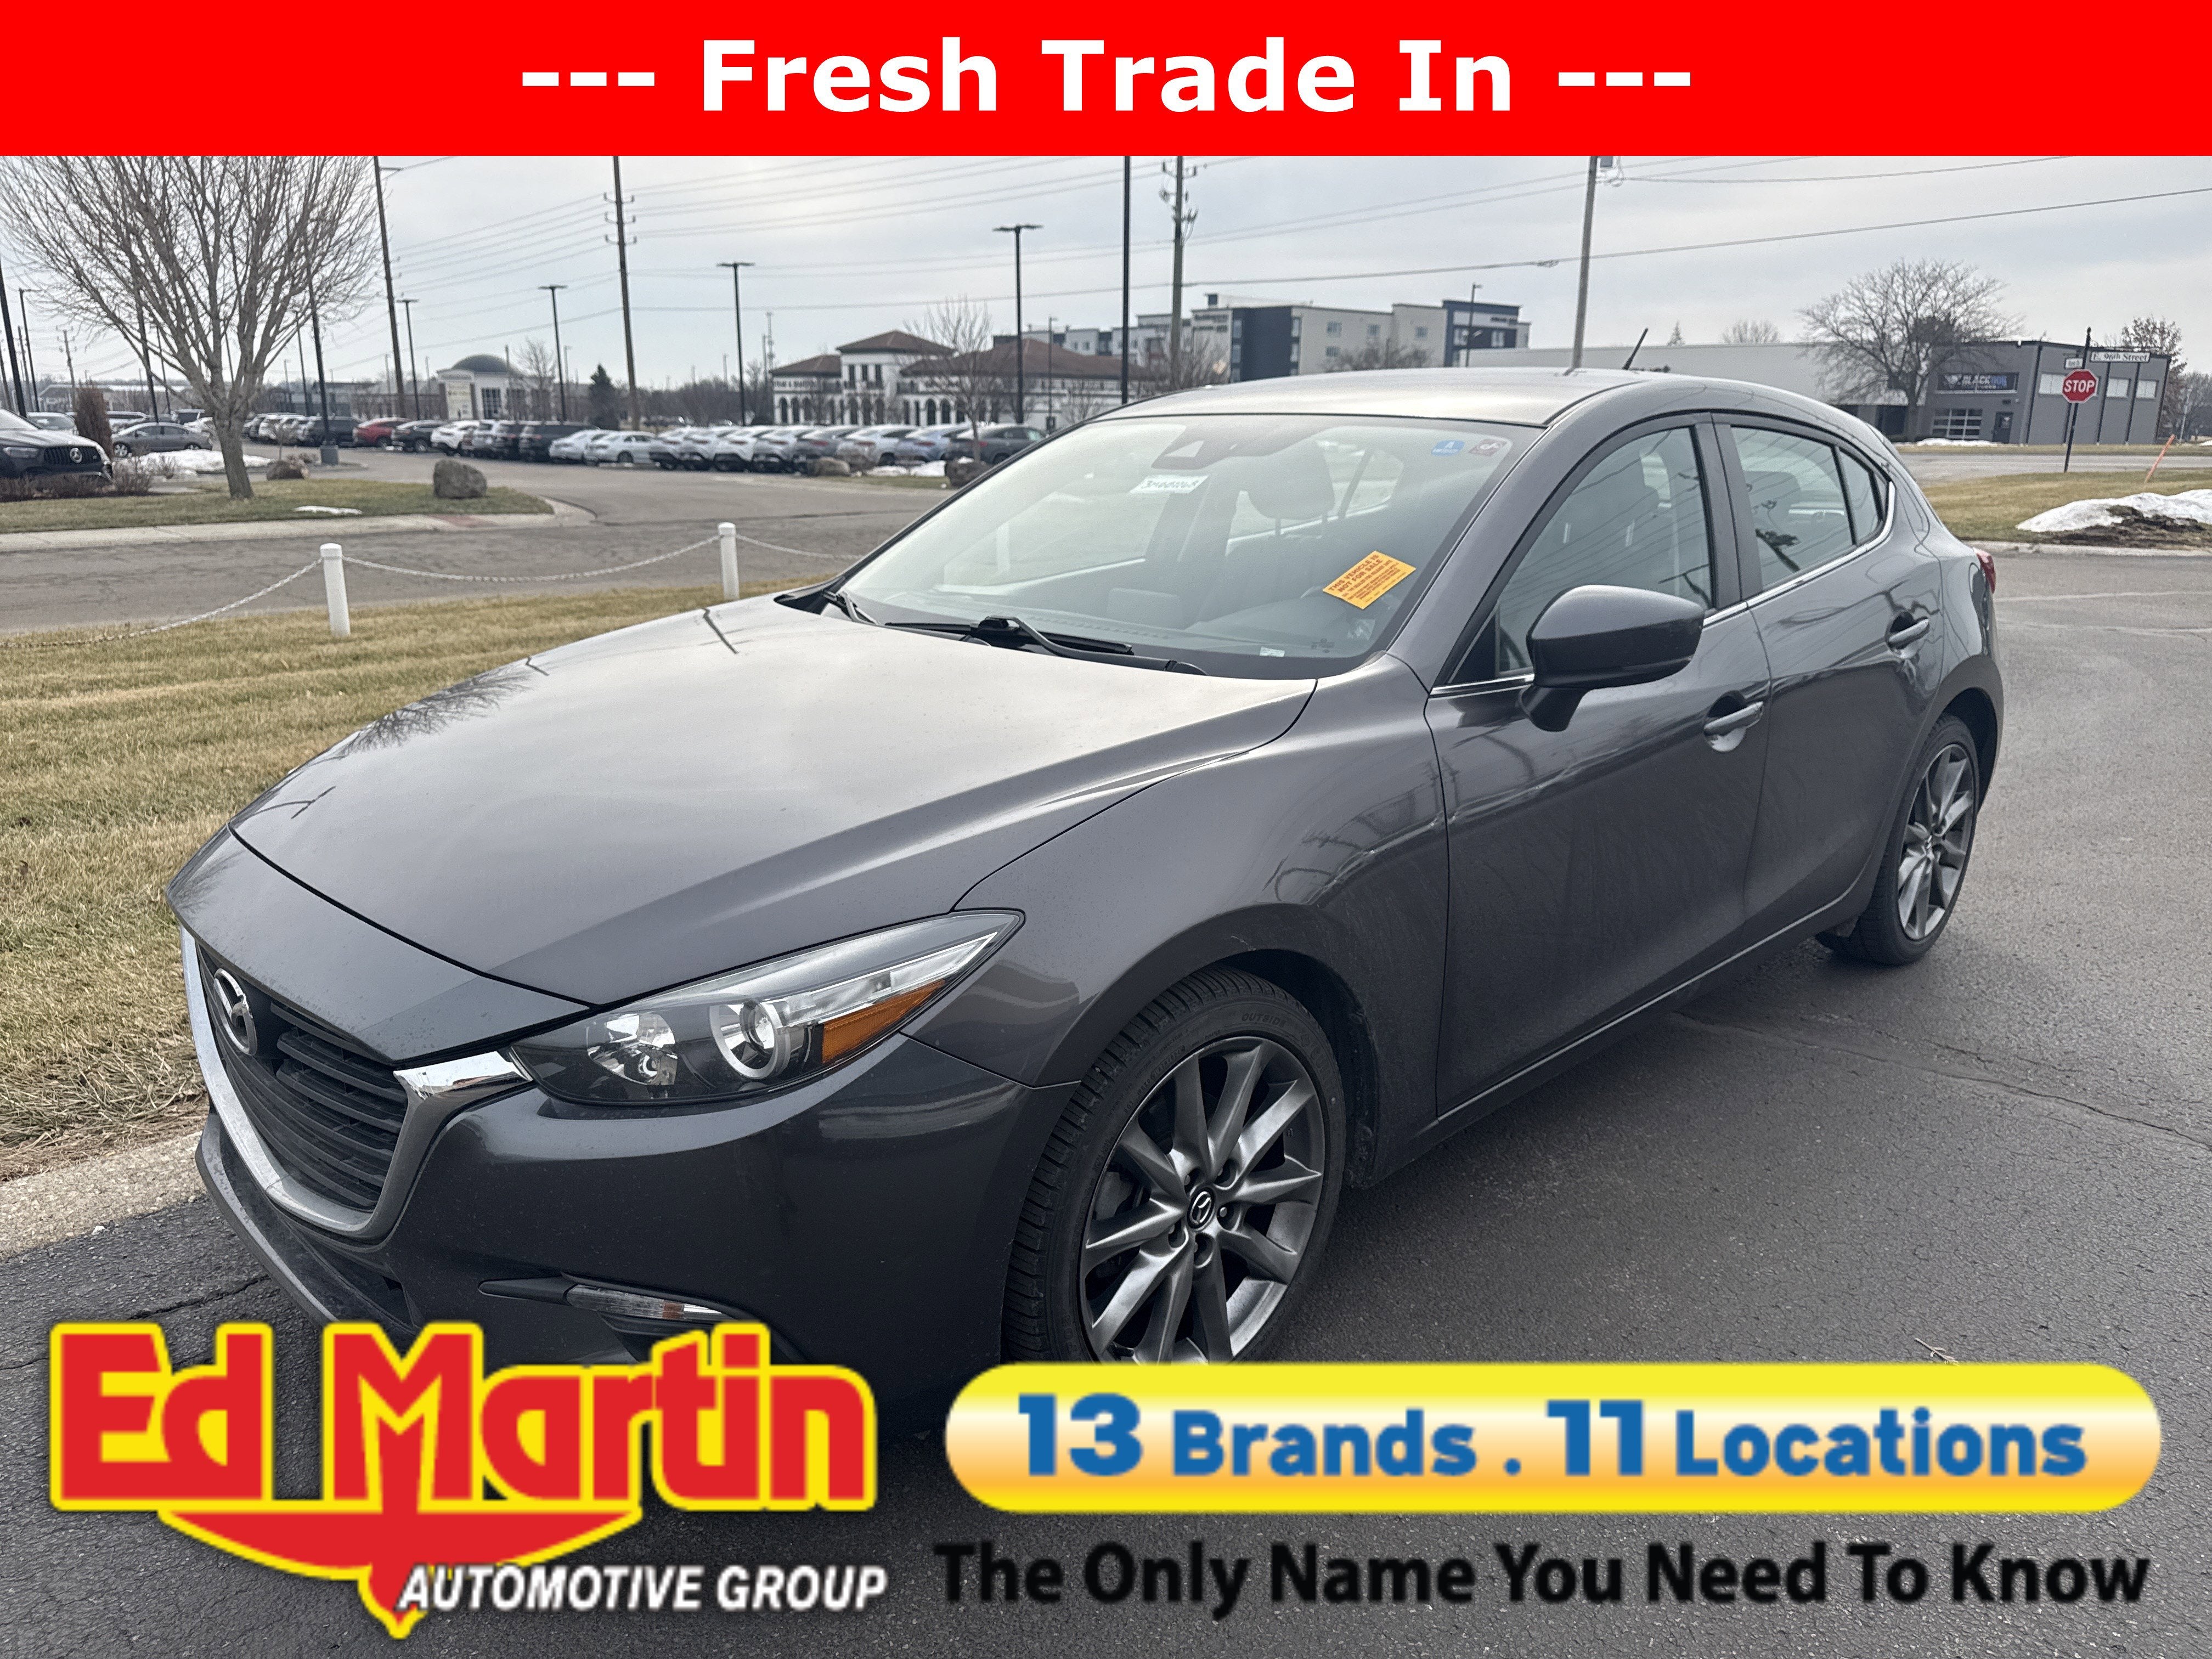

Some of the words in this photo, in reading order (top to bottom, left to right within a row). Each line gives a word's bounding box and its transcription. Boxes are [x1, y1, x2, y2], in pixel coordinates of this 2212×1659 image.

[2123, 353, 2148, 362] Street
[2064, 379, 2095, 393] STOP
[1328, 579, 1345, 591] THIS
[1344, 560, 1372, 579] VEHICLE
[1338, 581, 1352, 592] NOT
[1351, 571, 1367, 582] FOR
[1364, 559, 1383, 572] SALE
[1242, 1013, 1287, 1028] OUTSIDE
